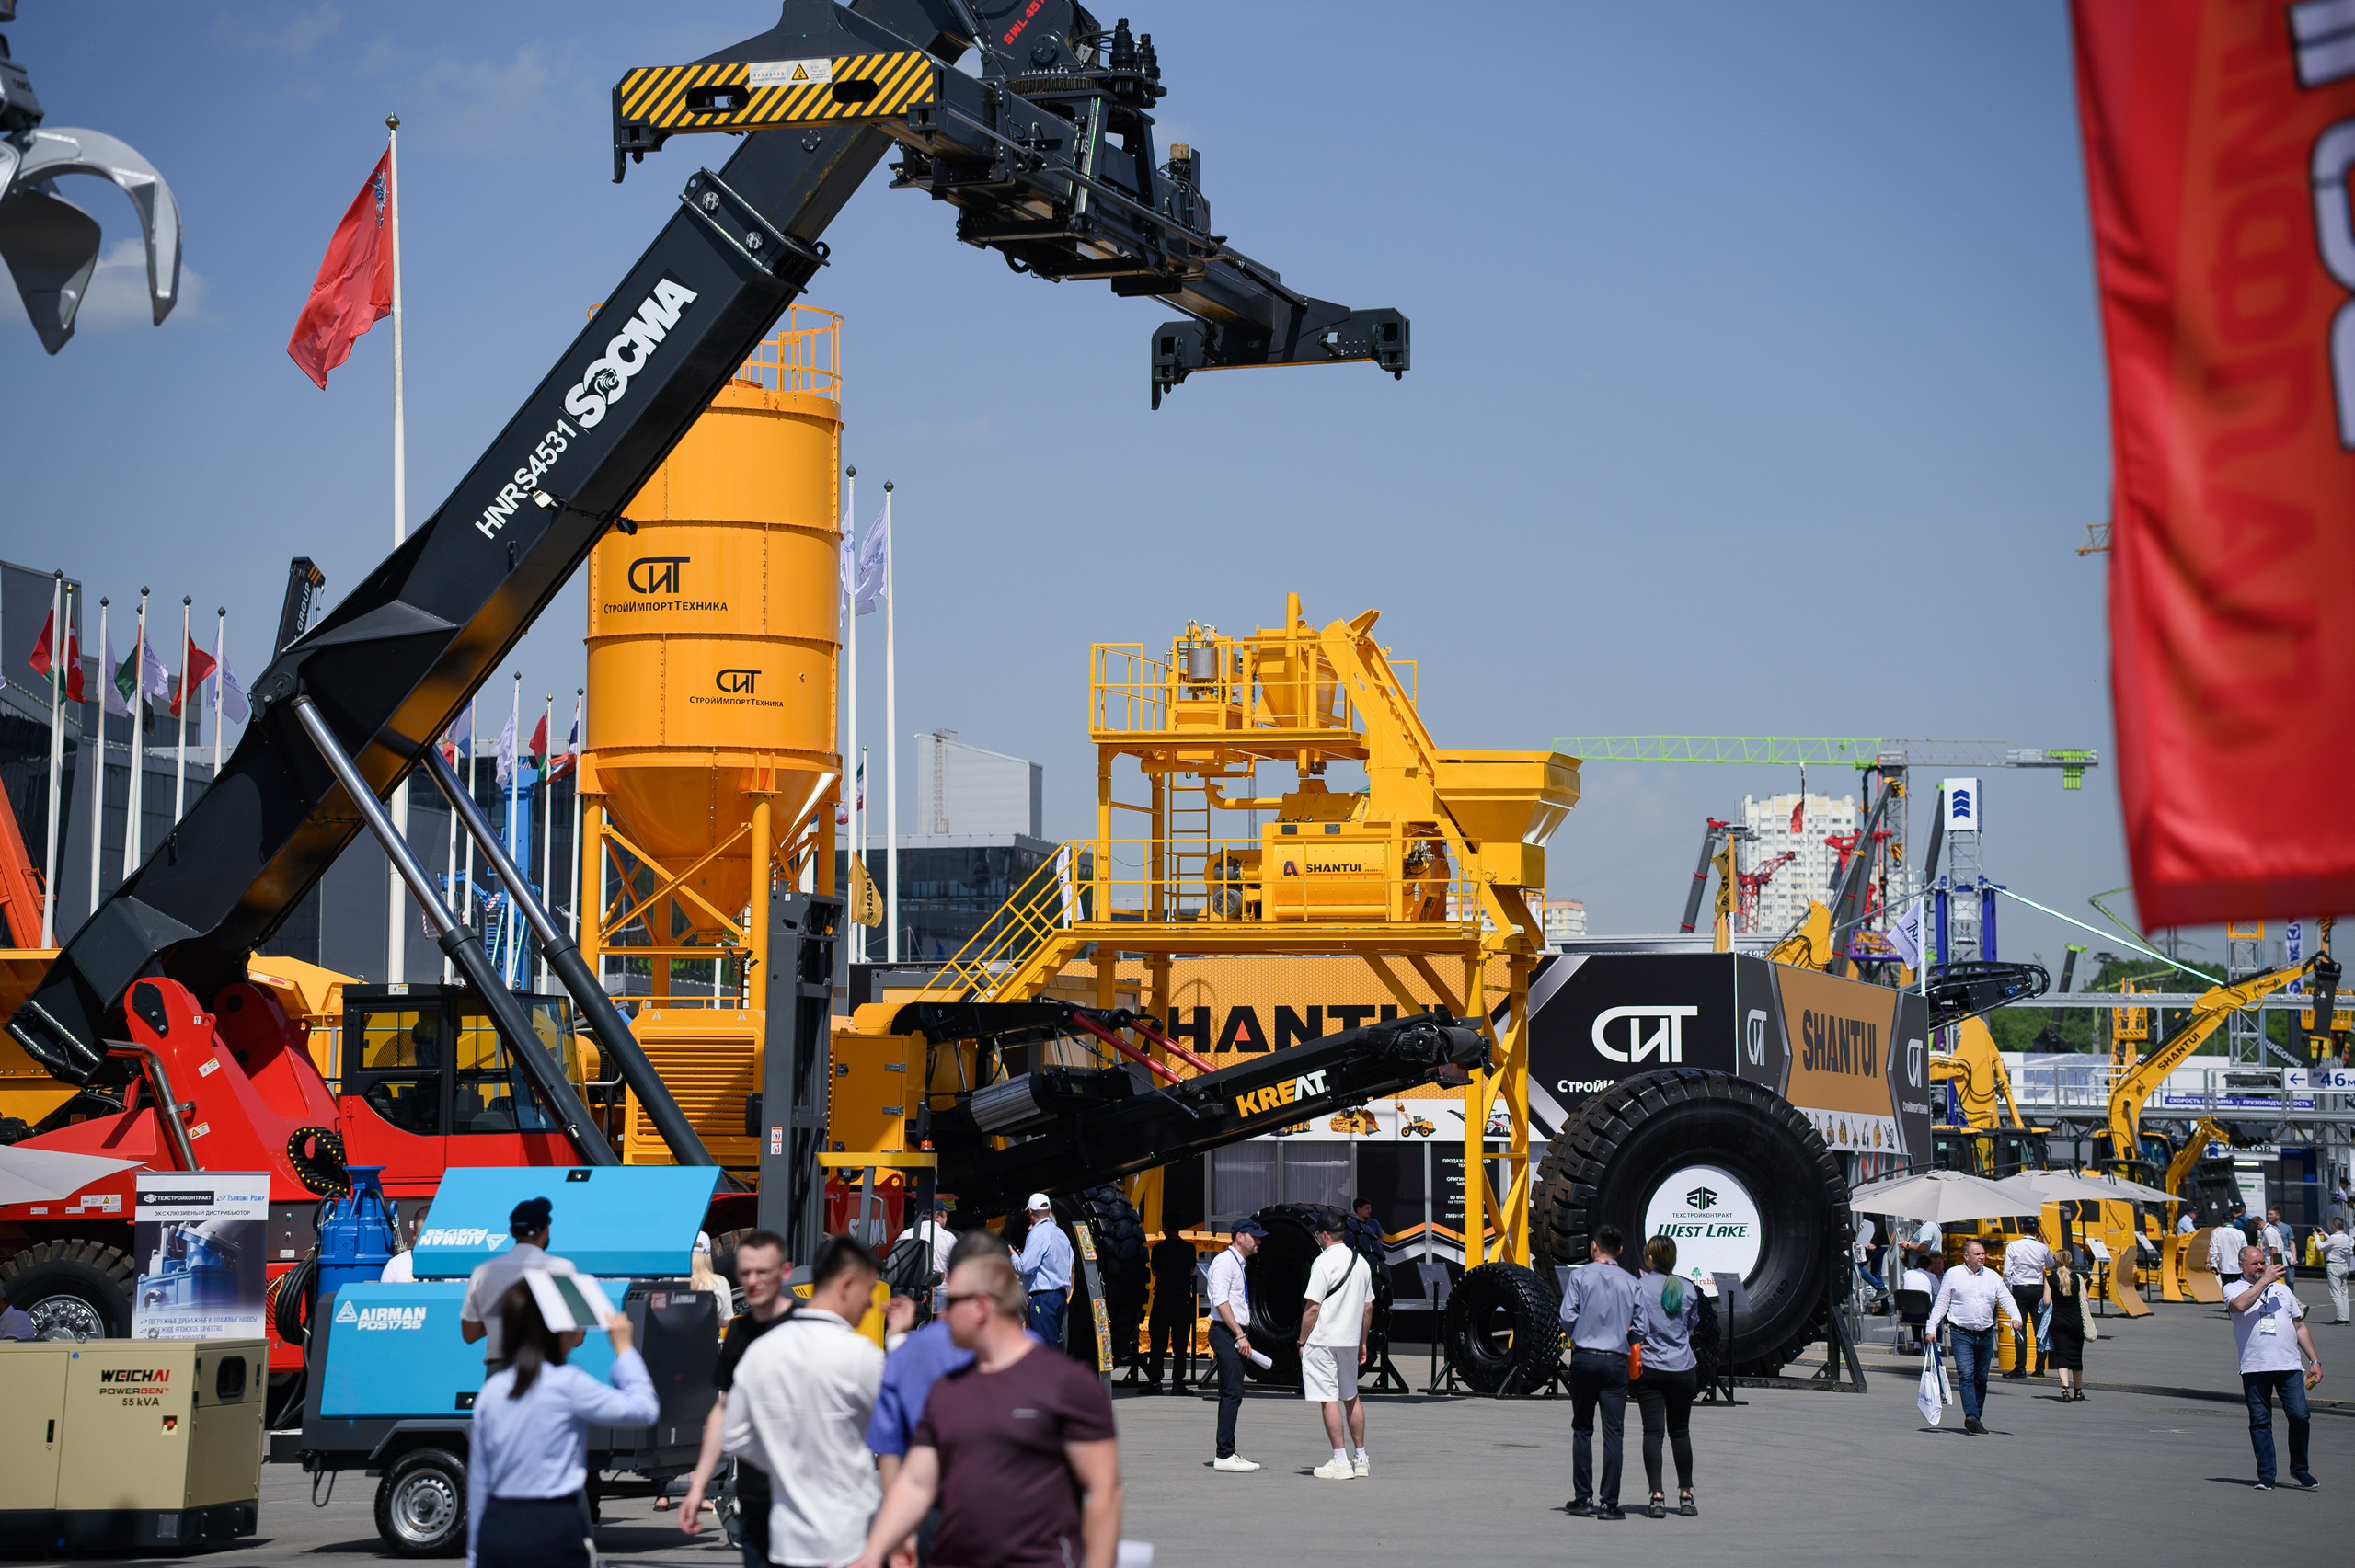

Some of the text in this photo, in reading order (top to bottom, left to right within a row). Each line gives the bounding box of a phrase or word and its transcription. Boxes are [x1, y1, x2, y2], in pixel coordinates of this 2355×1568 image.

[1003, 0, 1045, 45] SWL 45
[475, 278, 698, 540] HNRS4531 SOCMA
[627, 556, 691, 594] СИТ
[297, 582, 310, 632] GROUP
[715, 669, 762, 694] СИТ
[1306, 864, 1361, 873] SHANTUI
[866, 869, 875, 920] SHANT
[1141, 1004, 1458, 1054] HANT
[1591, 1005, 1698, 1063] СИТ
[1746, 1008, 1767, 1067] СИТ
[1802, 1008, 1878, 1079] SHANTUI
[2157, 1032, 2200, 1071] SHANTUI
[1907, 1037, 1924, 1089] СИТ
[1235, 1069, 1327, 1118] KREAT
[418, 1234, 487, 1246] AIRMAN
[1657, 1223, 1748, 1238] WEST LAKE
[359, 1307, 427, 1321] AIRMAN
[101, 1369, 170, 1382] WEICHAI
[122, 1397, 160, 1407] 55 kVA
